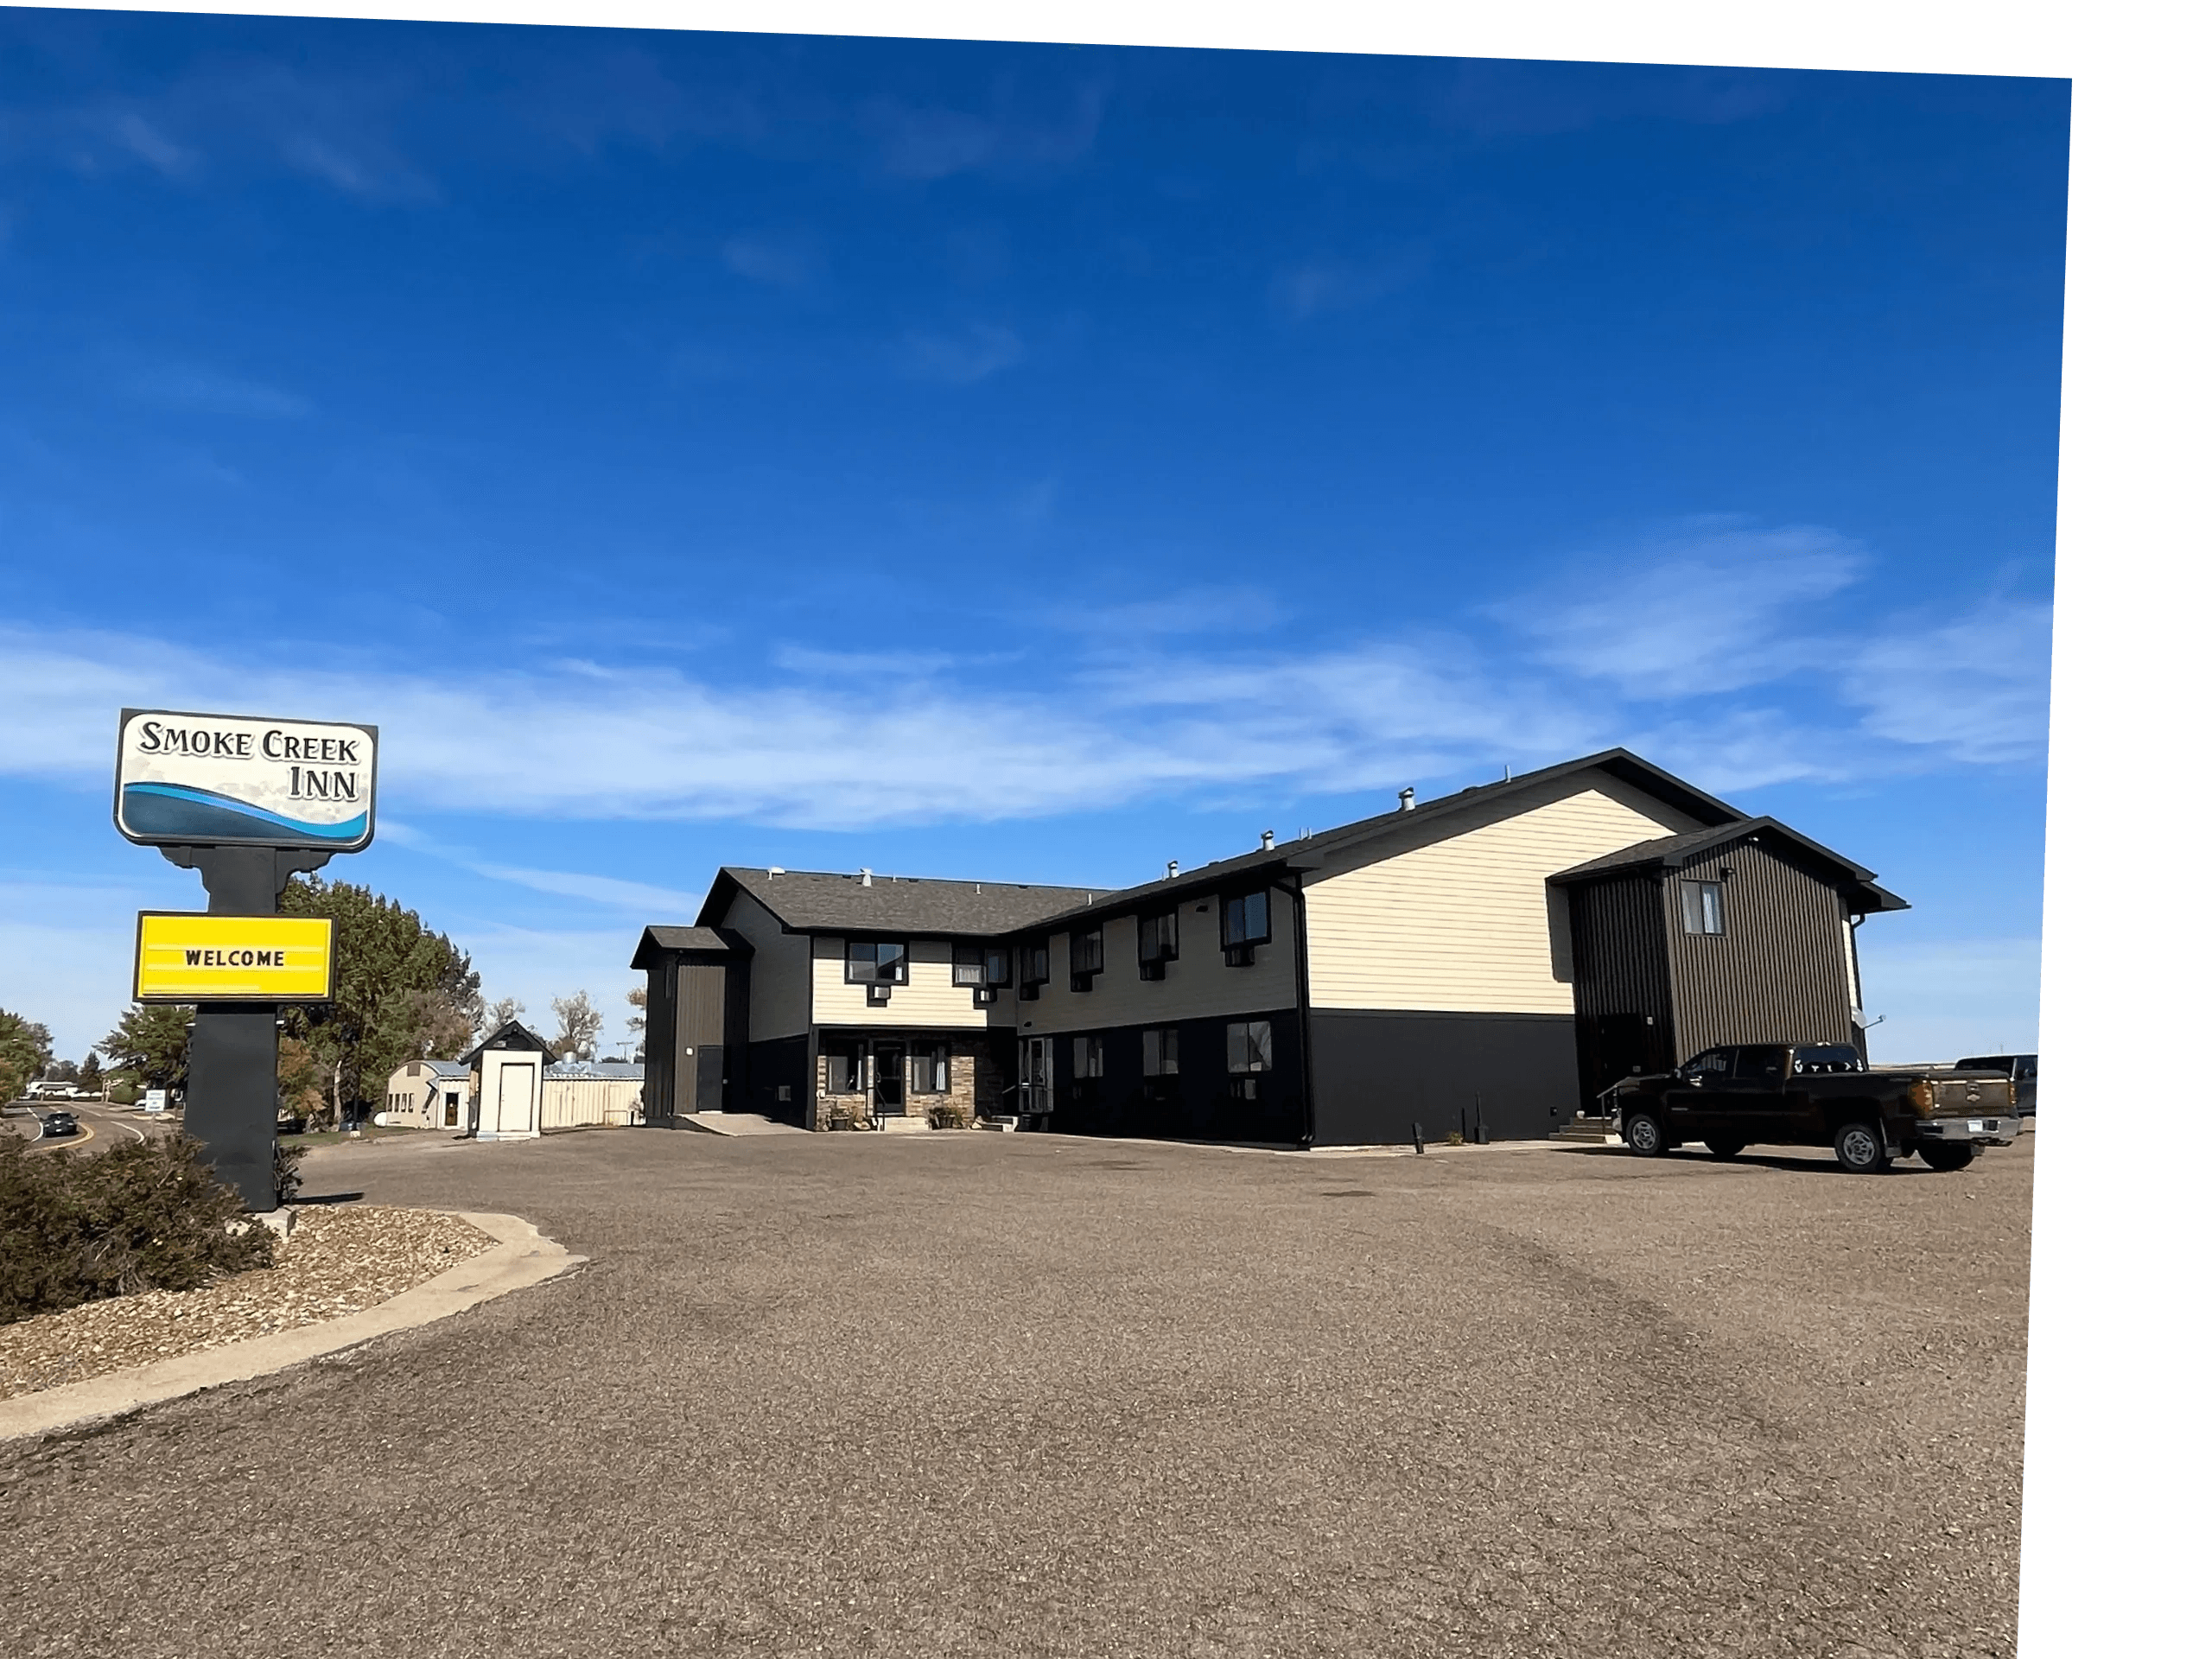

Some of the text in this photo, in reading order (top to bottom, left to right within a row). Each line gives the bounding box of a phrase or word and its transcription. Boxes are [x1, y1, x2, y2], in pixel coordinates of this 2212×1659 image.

[140, 721, 357, 762] SMOKE CREEK
[290, 766, 356, 798] INN
[185, 950, 285, 967] WELCOME
